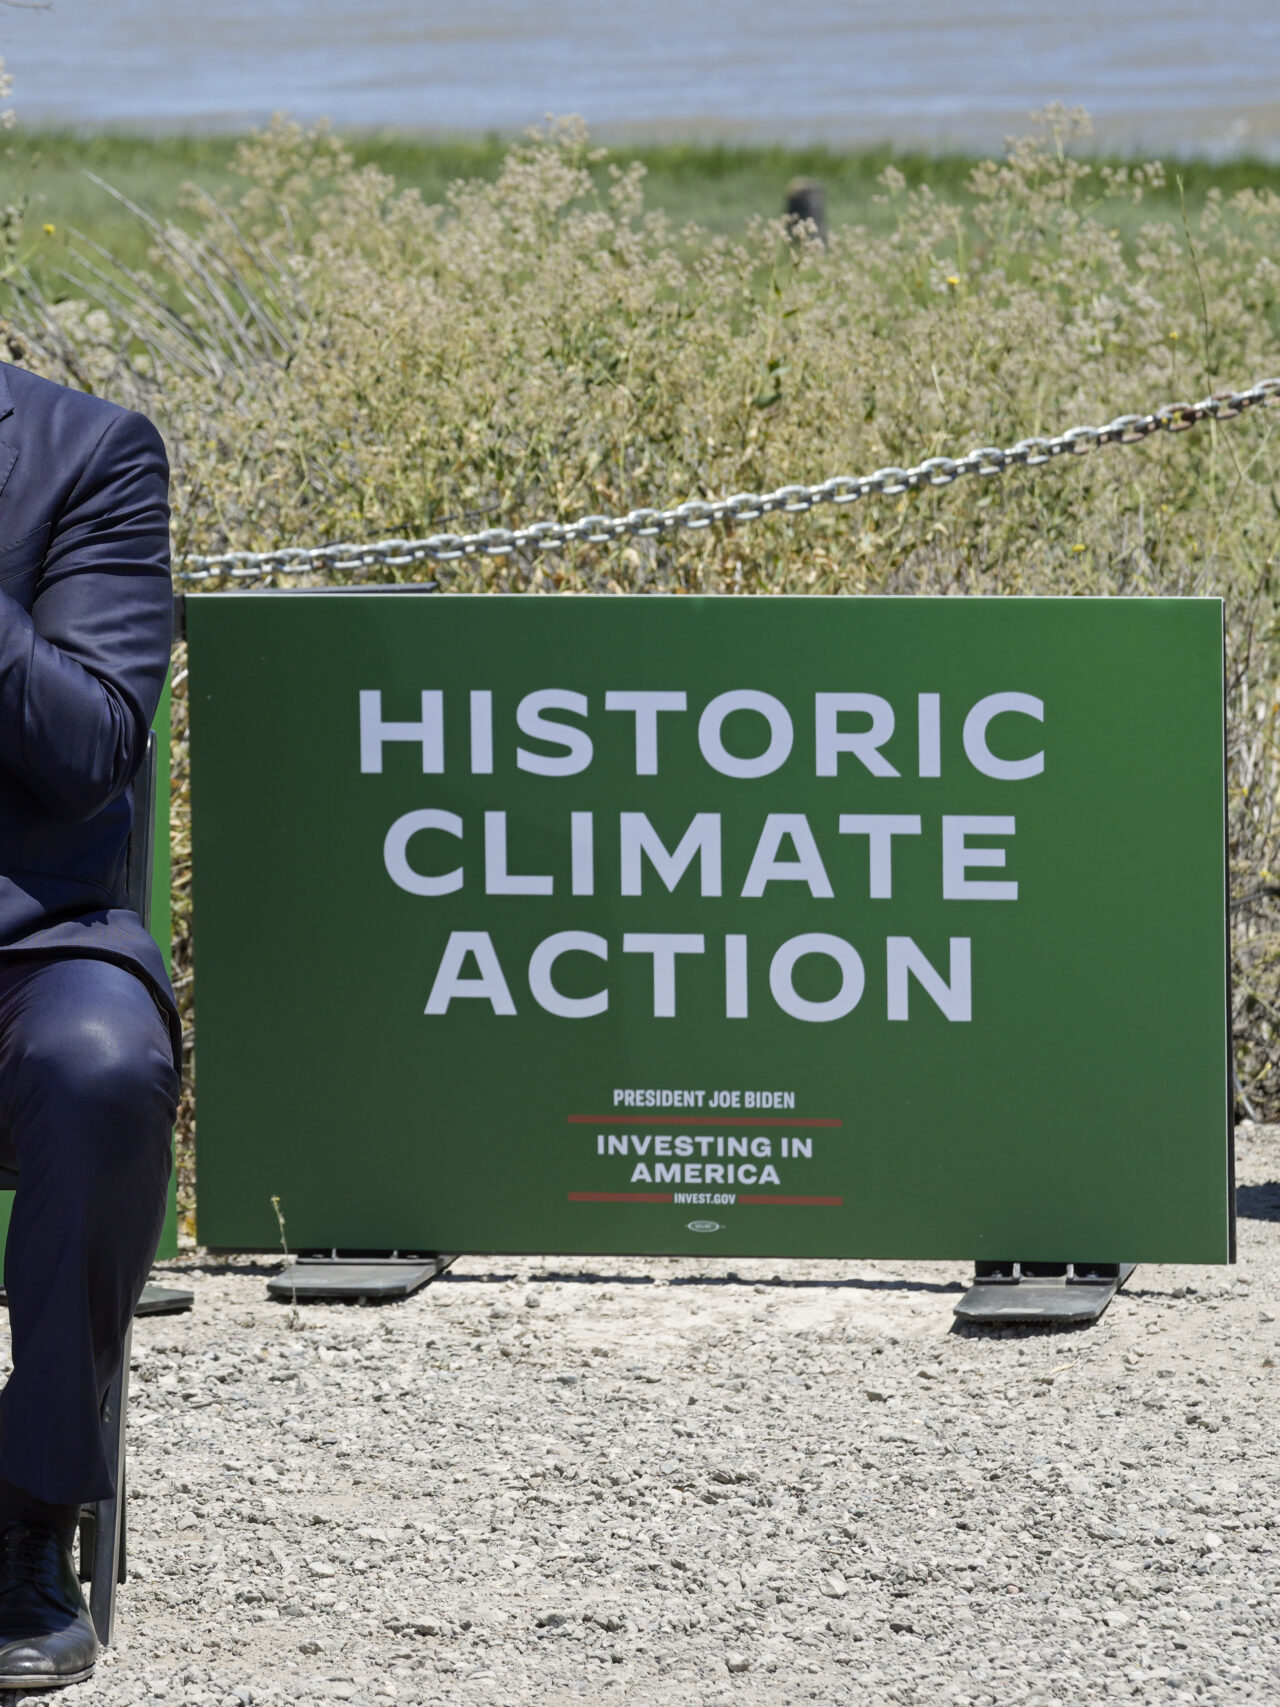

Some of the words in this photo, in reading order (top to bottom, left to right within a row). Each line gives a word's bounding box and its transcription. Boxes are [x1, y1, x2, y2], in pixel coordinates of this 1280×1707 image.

[359, 688, 1045, 781] HISTORIC
[383, 808, 1019, 901] CLIMATE
[424, 930, 972, 1023] ACTION
[613, 1089, 706, 1108] PRESIDENT
[708, 1090, 741, 1109] JOE
[744, 1091, 796, 1109] BIDEN
[597, 1134, 772, 1158] INVESTING
[780, 1136, 813, 1159] IN
[630, 1162, 781, 1185] AMERICA
[673, 1192, 736, 1205] INVEST.GOV
